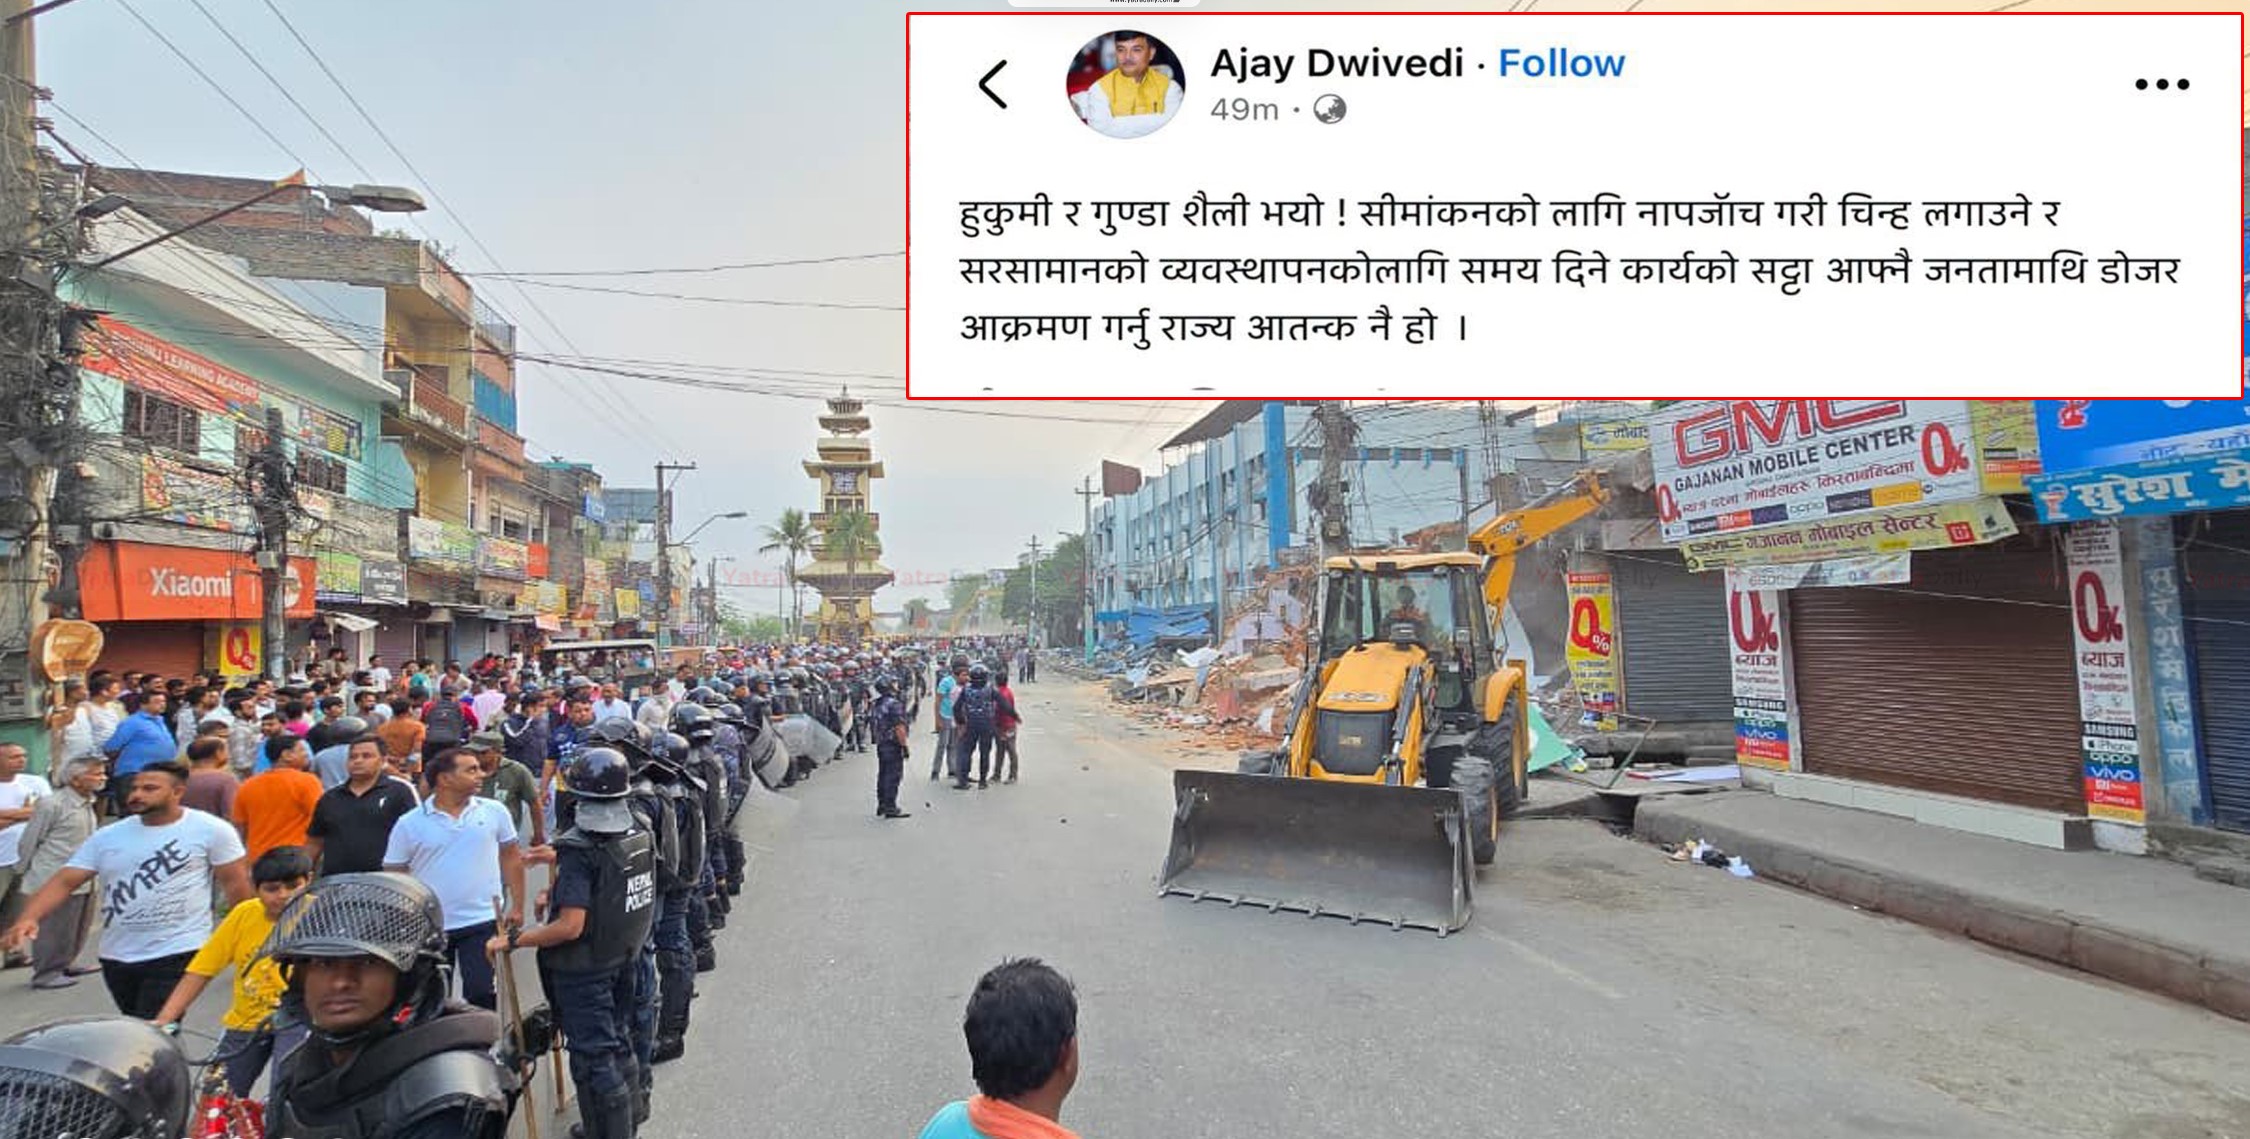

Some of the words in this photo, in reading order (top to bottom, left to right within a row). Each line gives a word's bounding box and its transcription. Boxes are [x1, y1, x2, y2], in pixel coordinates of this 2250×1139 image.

[1675, 468, 1745, 492] GAJANAN
[1749, 447, 1820, 477] MOBILE
[1826, 425, 1915, 459] CENTER
[1919, 421, 1970, 478] 0%
[2071, 471, 2194, 516] सुरेश
[150, 566, 232, 598] Xiaomi
[1571, 596, 1612, 658] 0%
[2074, 570, 2124, 644] 0%
[2084, 723, 2135, 739] SAMSUNG
[625, 887, 653, 913] POLICE
[626, 870, 653, 895] NEPAL
